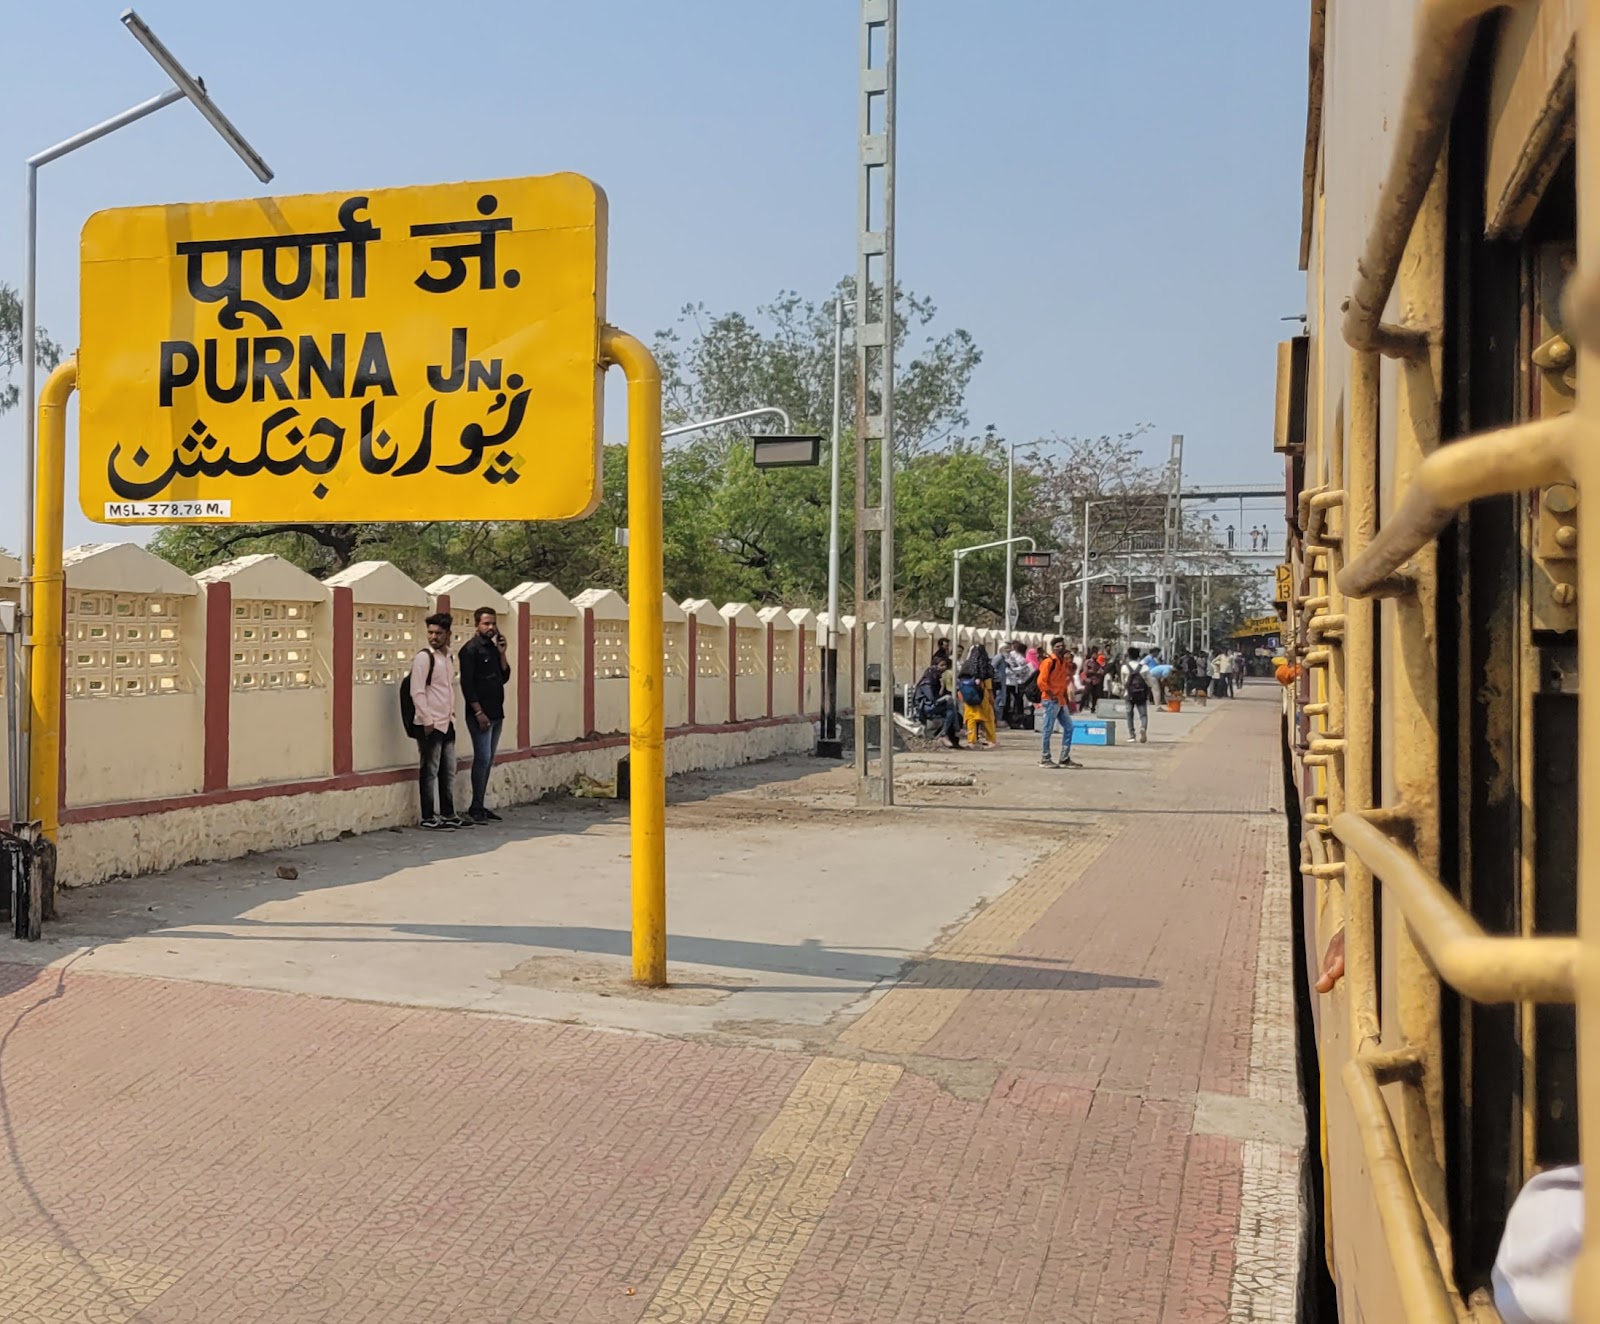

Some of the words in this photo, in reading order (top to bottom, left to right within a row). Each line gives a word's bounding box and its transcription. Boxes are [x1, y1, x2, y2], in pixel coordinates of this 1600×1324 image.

[176, 196, 381, 331] पूर्णा
[159, 332, 398, 407] PURNA
[1278, 584, 1291, 600] 13
